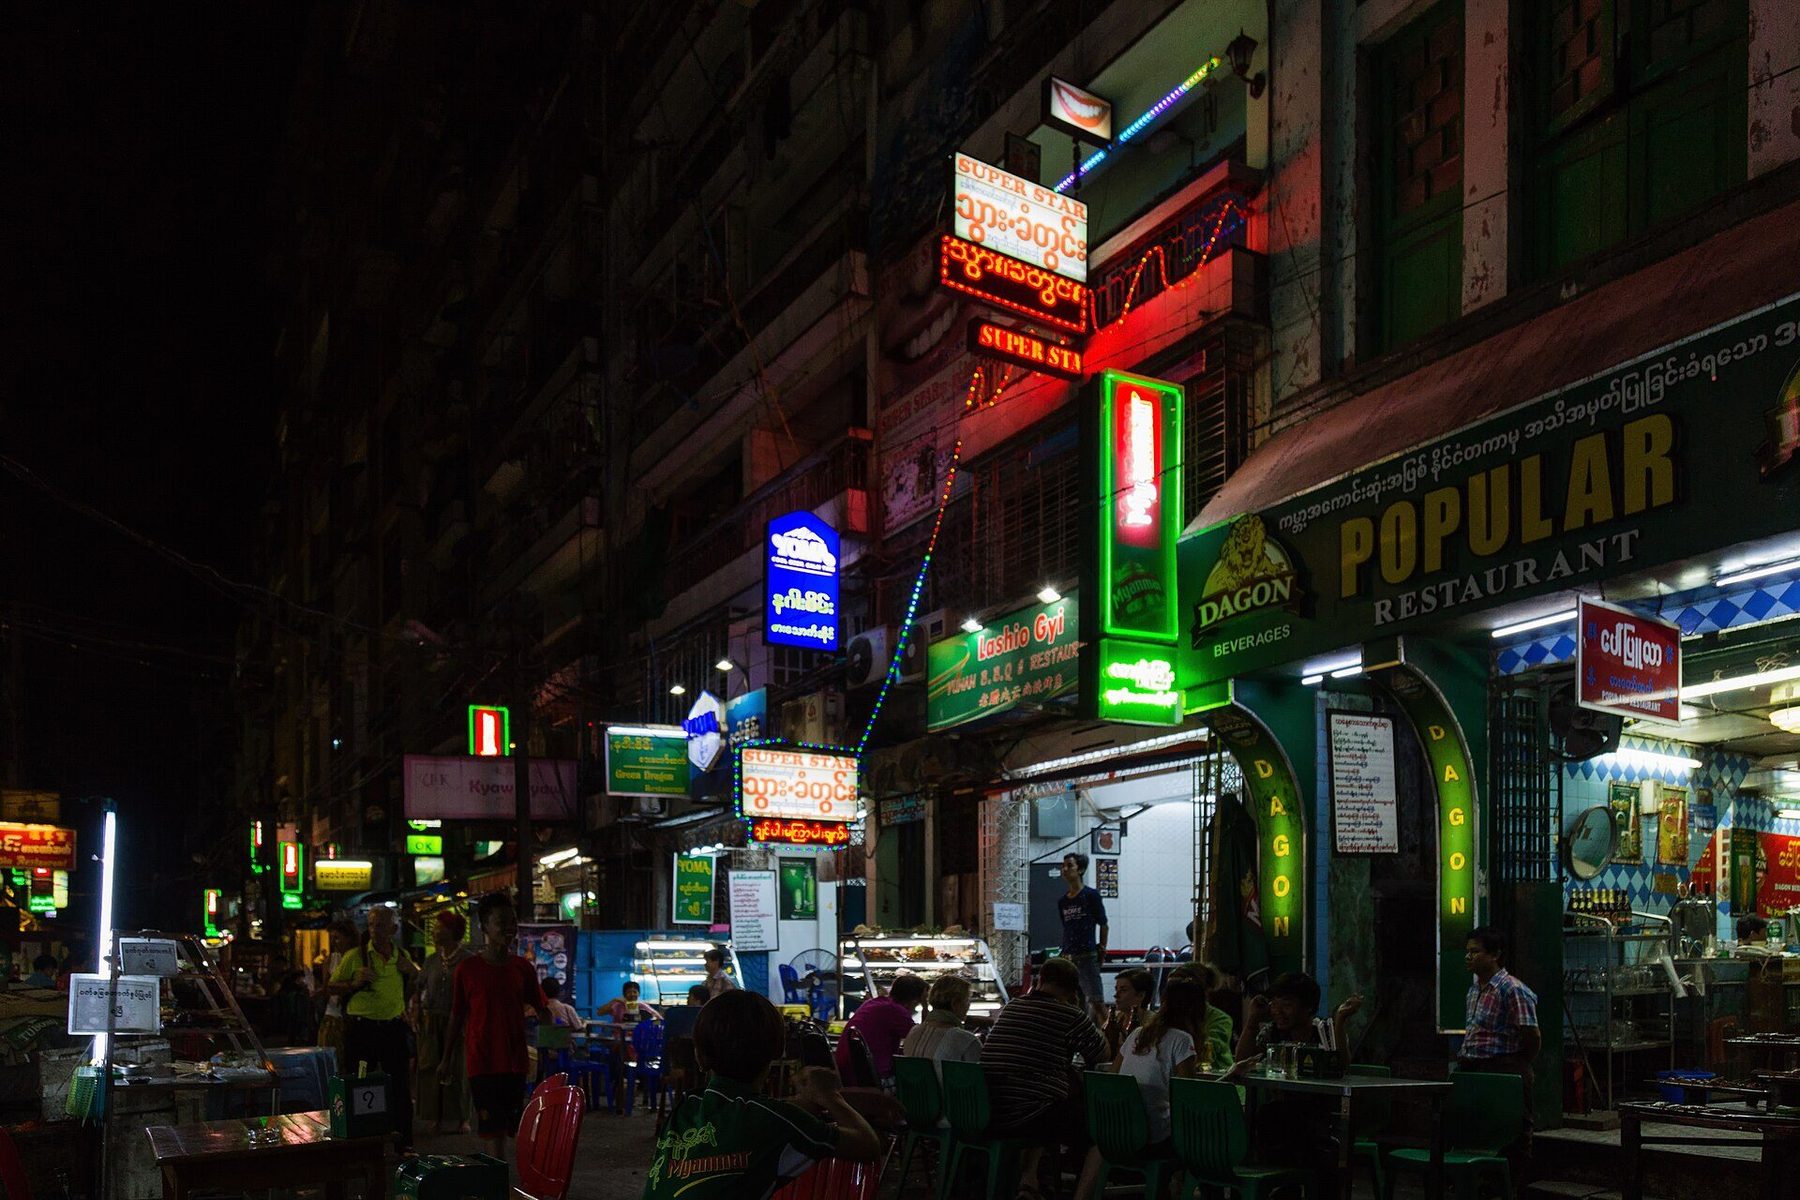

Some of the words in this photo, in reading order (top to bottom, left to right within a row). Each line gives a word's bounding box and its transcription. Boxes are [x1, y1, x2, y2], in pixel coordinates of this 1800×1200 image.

[957, 157, 1027, 197] SUPER
[1034, 187, 1087, 220] STAR
[980, 325, 1044, 362] SUPER
[1340, 414, 1676, 600] POPULAR
[1198, 576, 1294, 628] DAGON
[1373, 529, 1641, 627] RESTAURANT
[978, 622, 1030, 662] Lashio
[1034, 607, 1065, 646] Gyi
[1214, 625, 1291, 658] BEVERAGES
[744, 750, 804, 766] SUPER
[810, 756, 857, 770] STAR
[1429, 724, 1466, 915] DAGON
[678, 859, 712, 876] YOMA
[1254, 760, 1290, 938] DAGON
[667, 1151, 753, 1180] Myanmar
